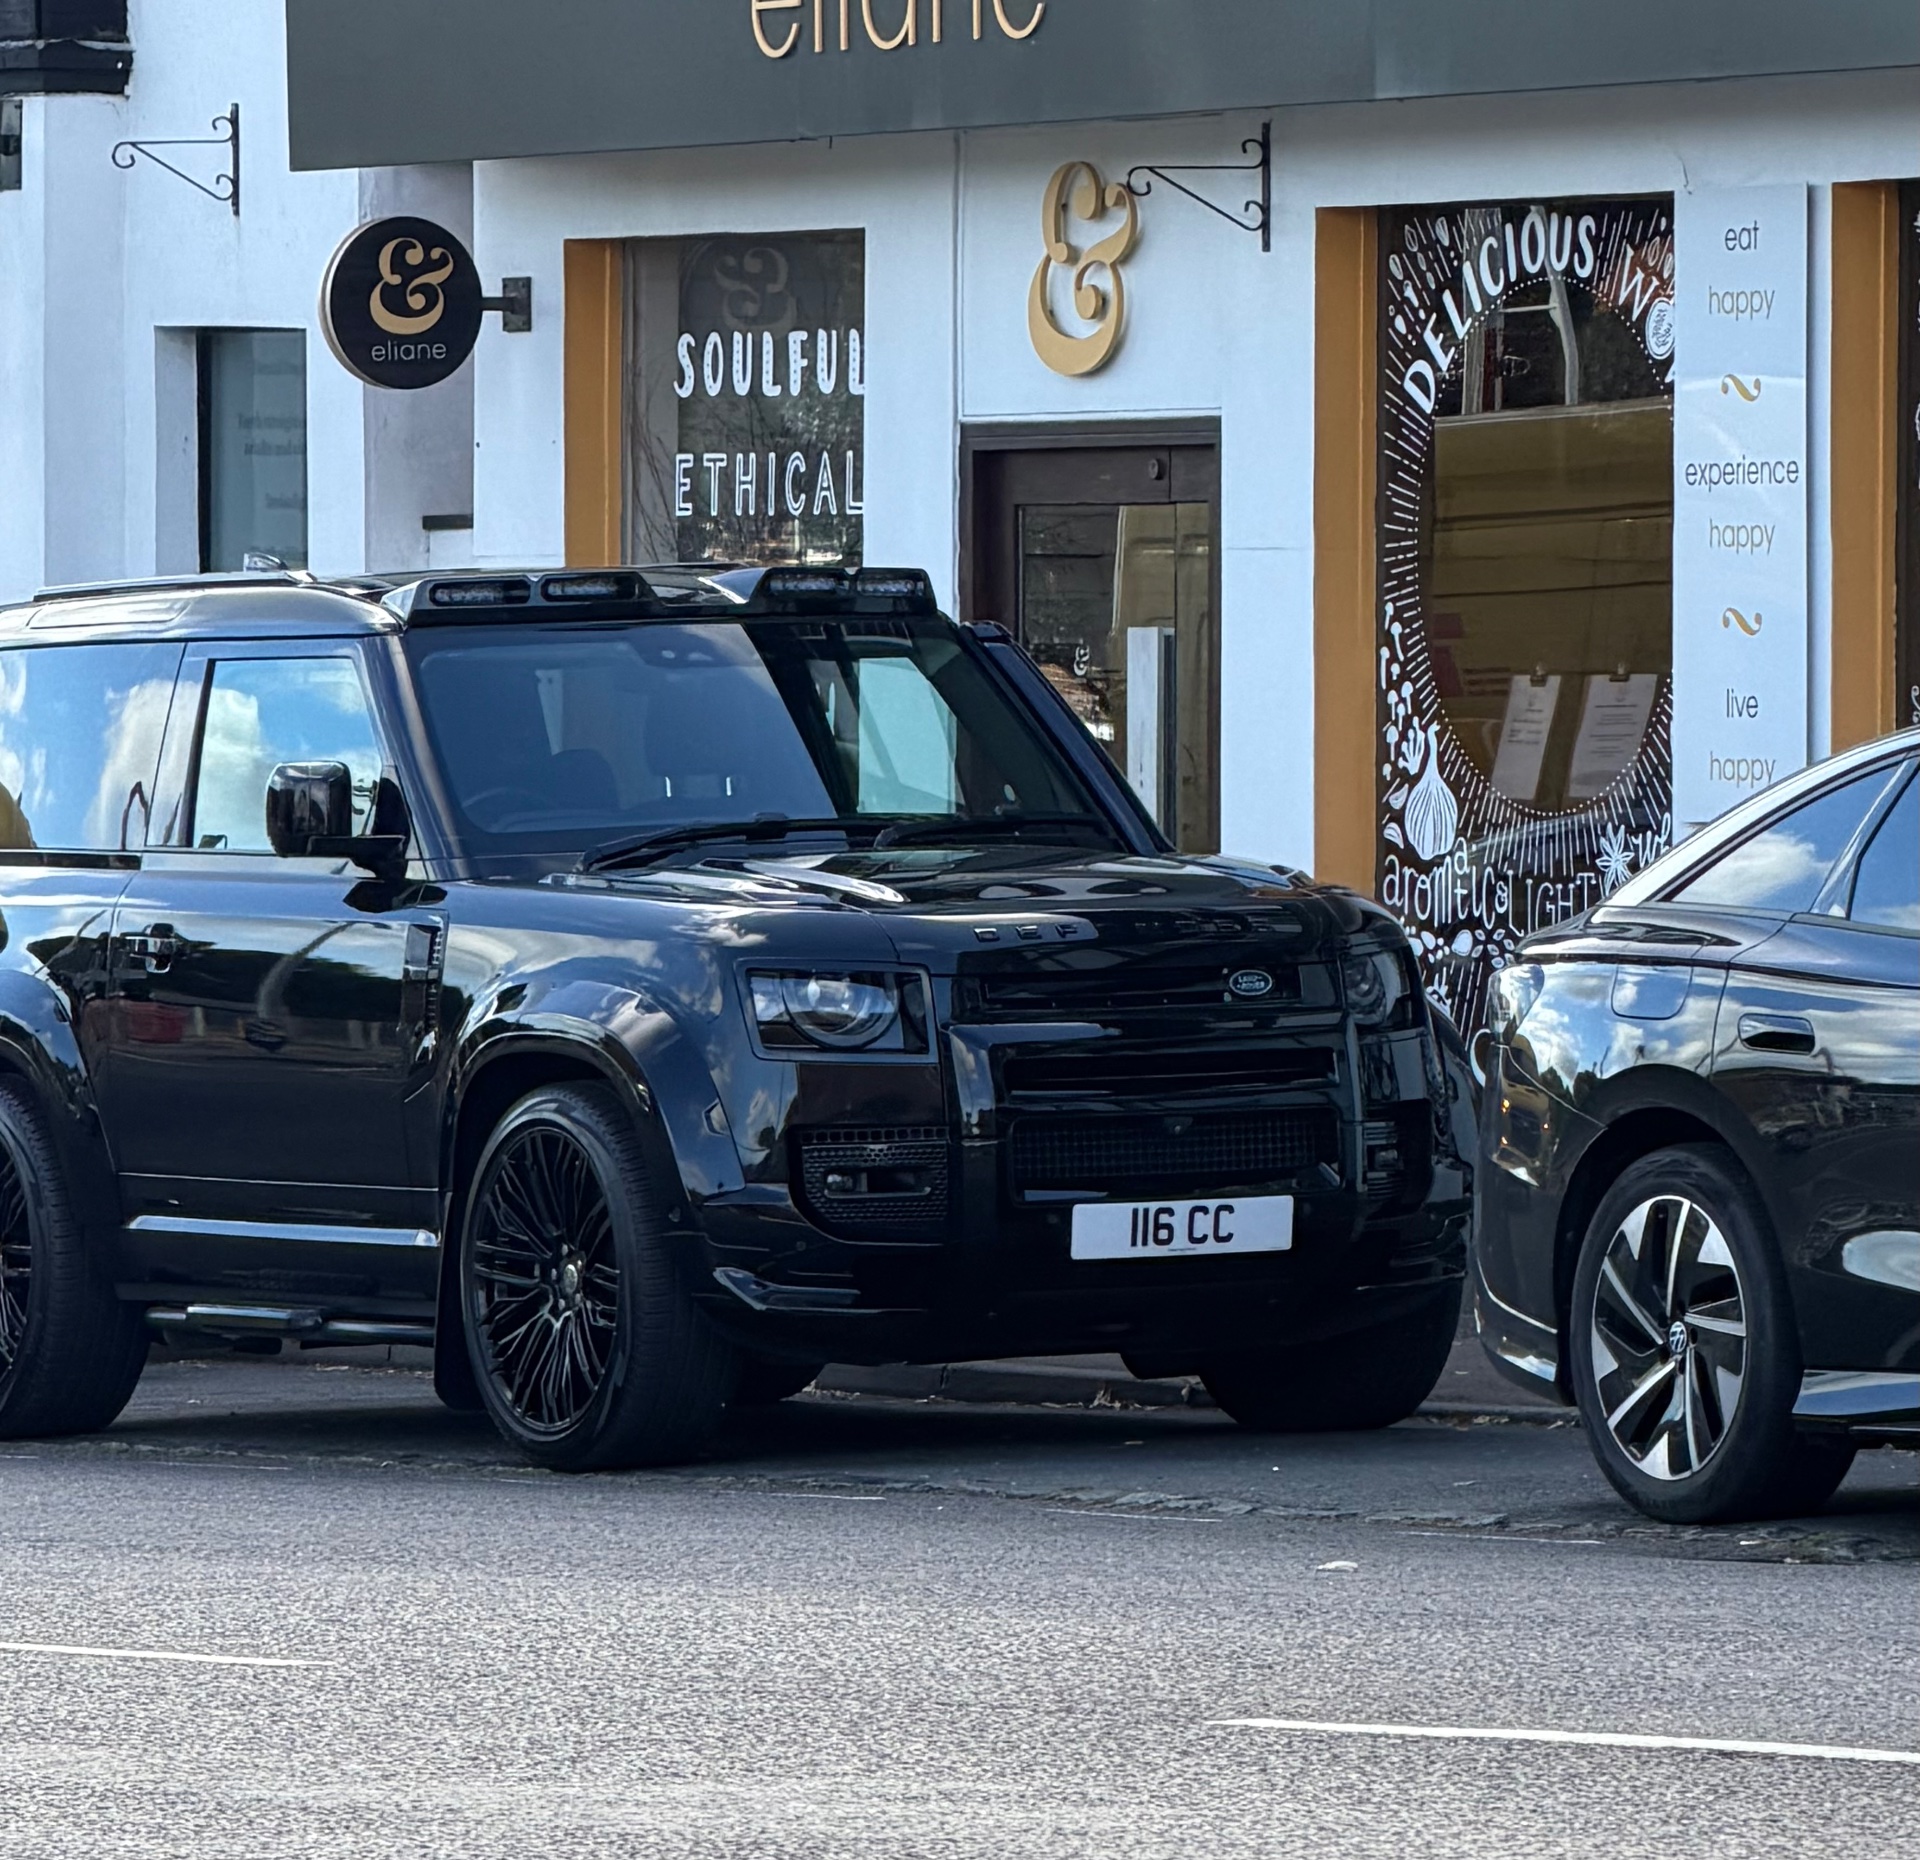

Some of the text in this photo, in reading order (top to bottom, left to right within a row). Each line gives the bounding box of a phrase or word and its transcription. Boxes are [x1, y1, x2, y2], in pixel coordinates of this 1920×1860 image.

[1724, 220, 1760, 252] eat
[1403, 211, 1597, 415] DELICIOUS
[1708, 285, 1776, 322] happy
[371, 340, 447, 362] eliane
[673, 327, 866, 399] SOULFUL
[675, 450, 865, 517] ETHICAL
[1684, 454, 1800, 493] experience
[1708, 517, 1777, 555] happy
[1725, 687, 1759, 719] live
[1709, 750, 1777, 789] happy
[1130, 1204, 1236, 1247] 116 CC
